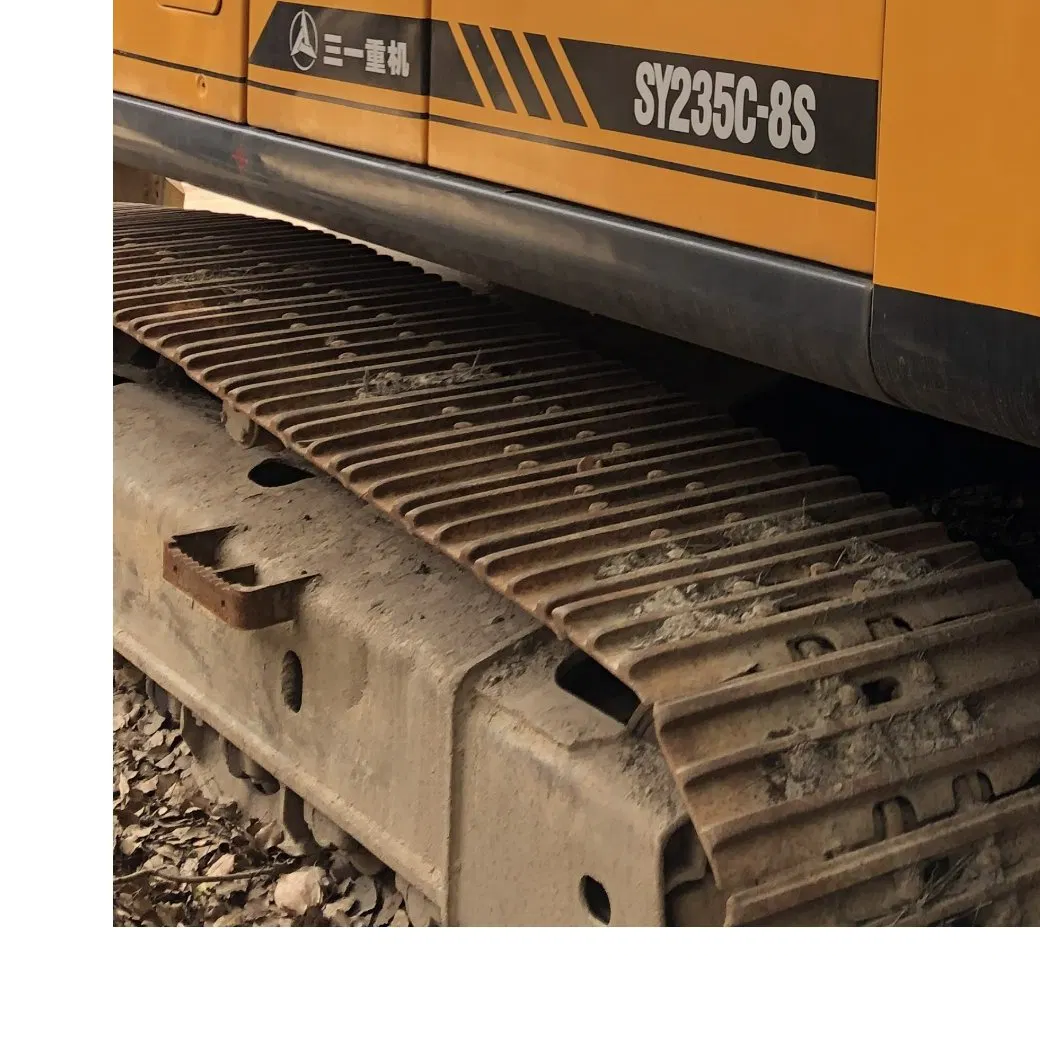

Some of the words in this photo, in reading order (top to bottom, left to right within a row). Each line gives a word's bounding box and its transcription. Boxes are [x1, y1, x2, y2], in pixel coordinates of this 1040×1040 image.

[323, 33, 410, 78] 三一重机
[633, 60, 816, 155] SY235C-8S
